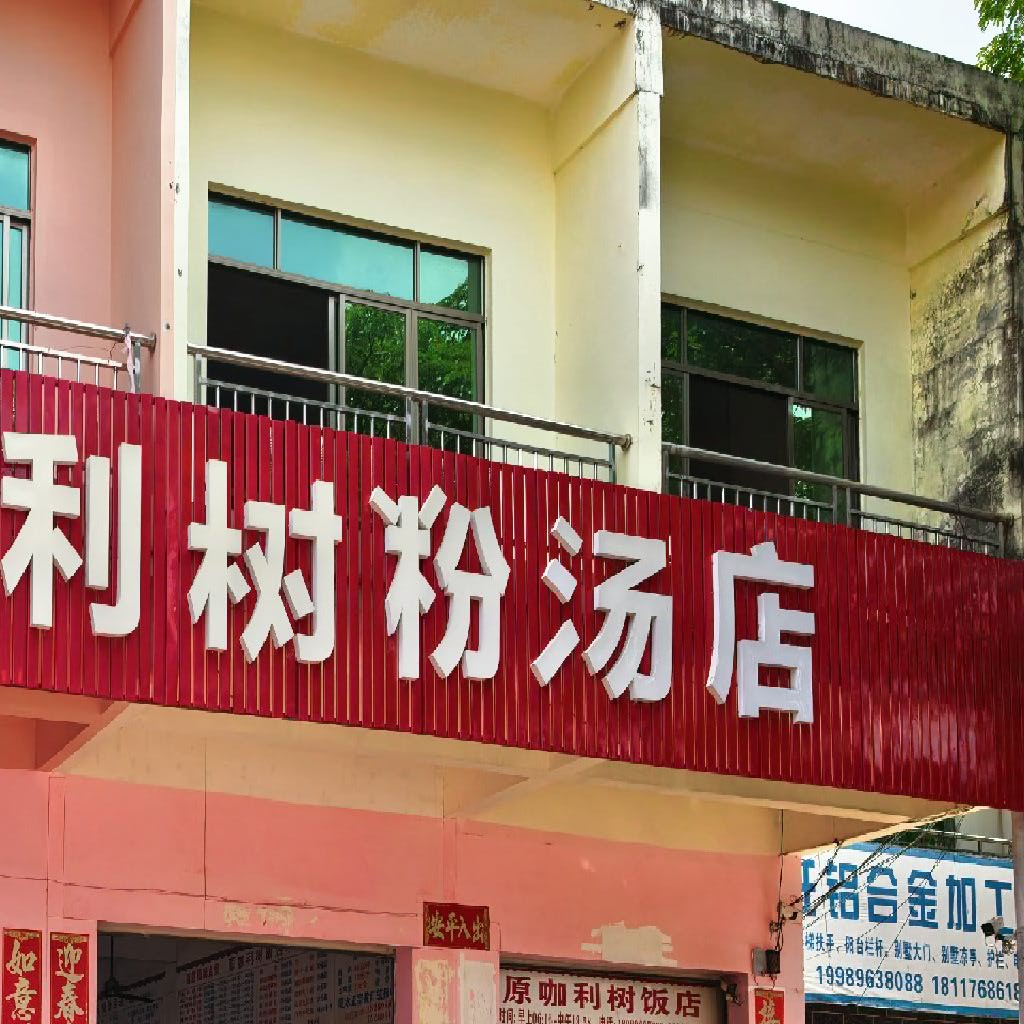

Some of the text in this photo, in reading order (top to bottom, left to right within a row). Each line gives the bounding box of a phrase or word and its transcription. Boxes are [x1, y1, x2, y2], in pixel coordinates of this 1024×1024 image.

[502, 975, 702, 1018] 原咖利树饭店
[816, 964, 925, 994] 19989638088
